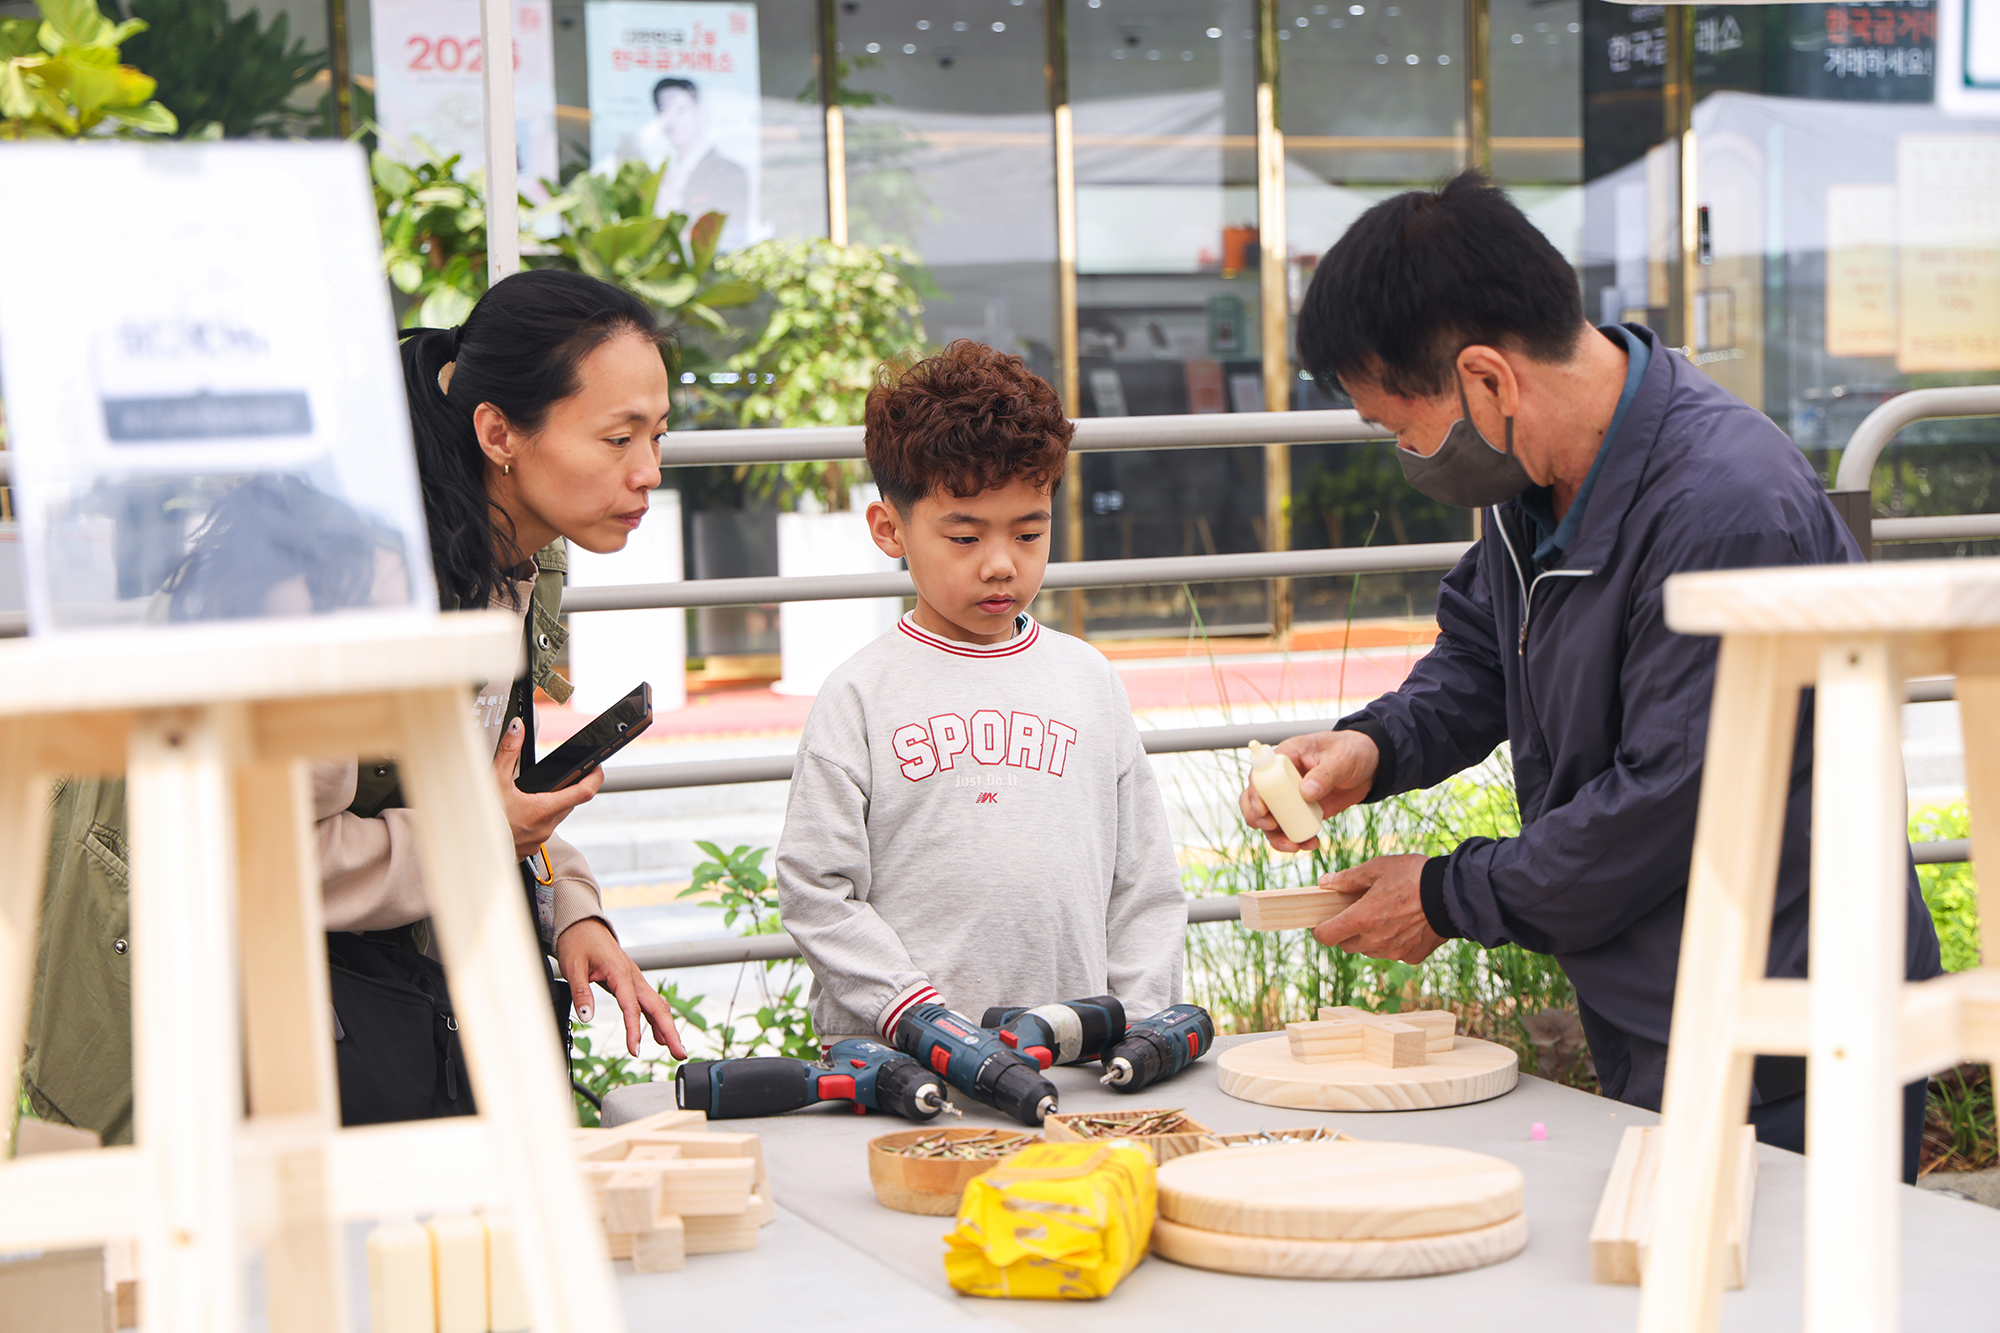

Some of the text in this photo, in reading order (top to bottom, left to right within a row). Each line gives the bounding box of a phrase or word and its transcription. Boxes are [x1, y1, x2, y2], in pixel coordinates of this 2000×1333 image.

[405, 35, 520, 73] 202
[891, 709, 1078, 783] SPORT
[955, 773, 982, 789] Just
[985, 772, 1003, 787] Do
